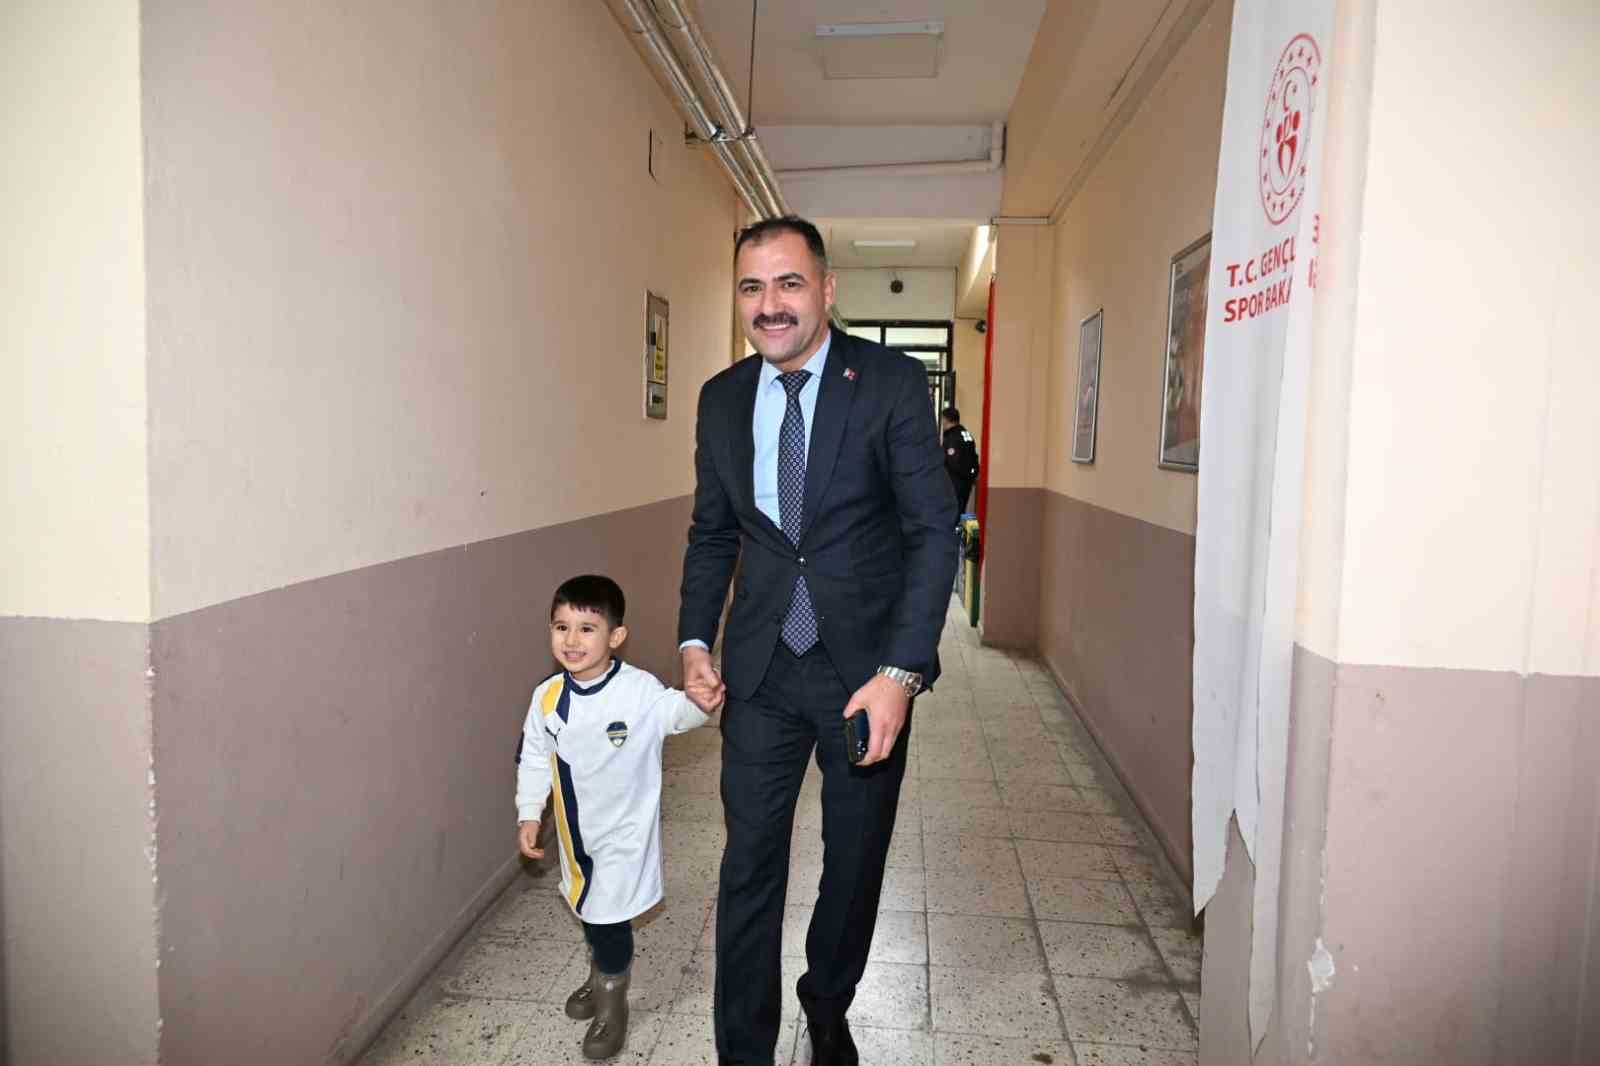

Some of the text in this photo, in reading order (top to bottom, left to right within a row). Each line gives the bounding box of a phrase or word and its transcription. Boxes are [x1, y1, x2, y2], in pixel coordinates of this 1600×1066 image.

[1226, 259, 1257, 287] T.C.
[1260, 236, 1295, 277] GENÇL
[1223, 291, 1264, 322] SPOR
